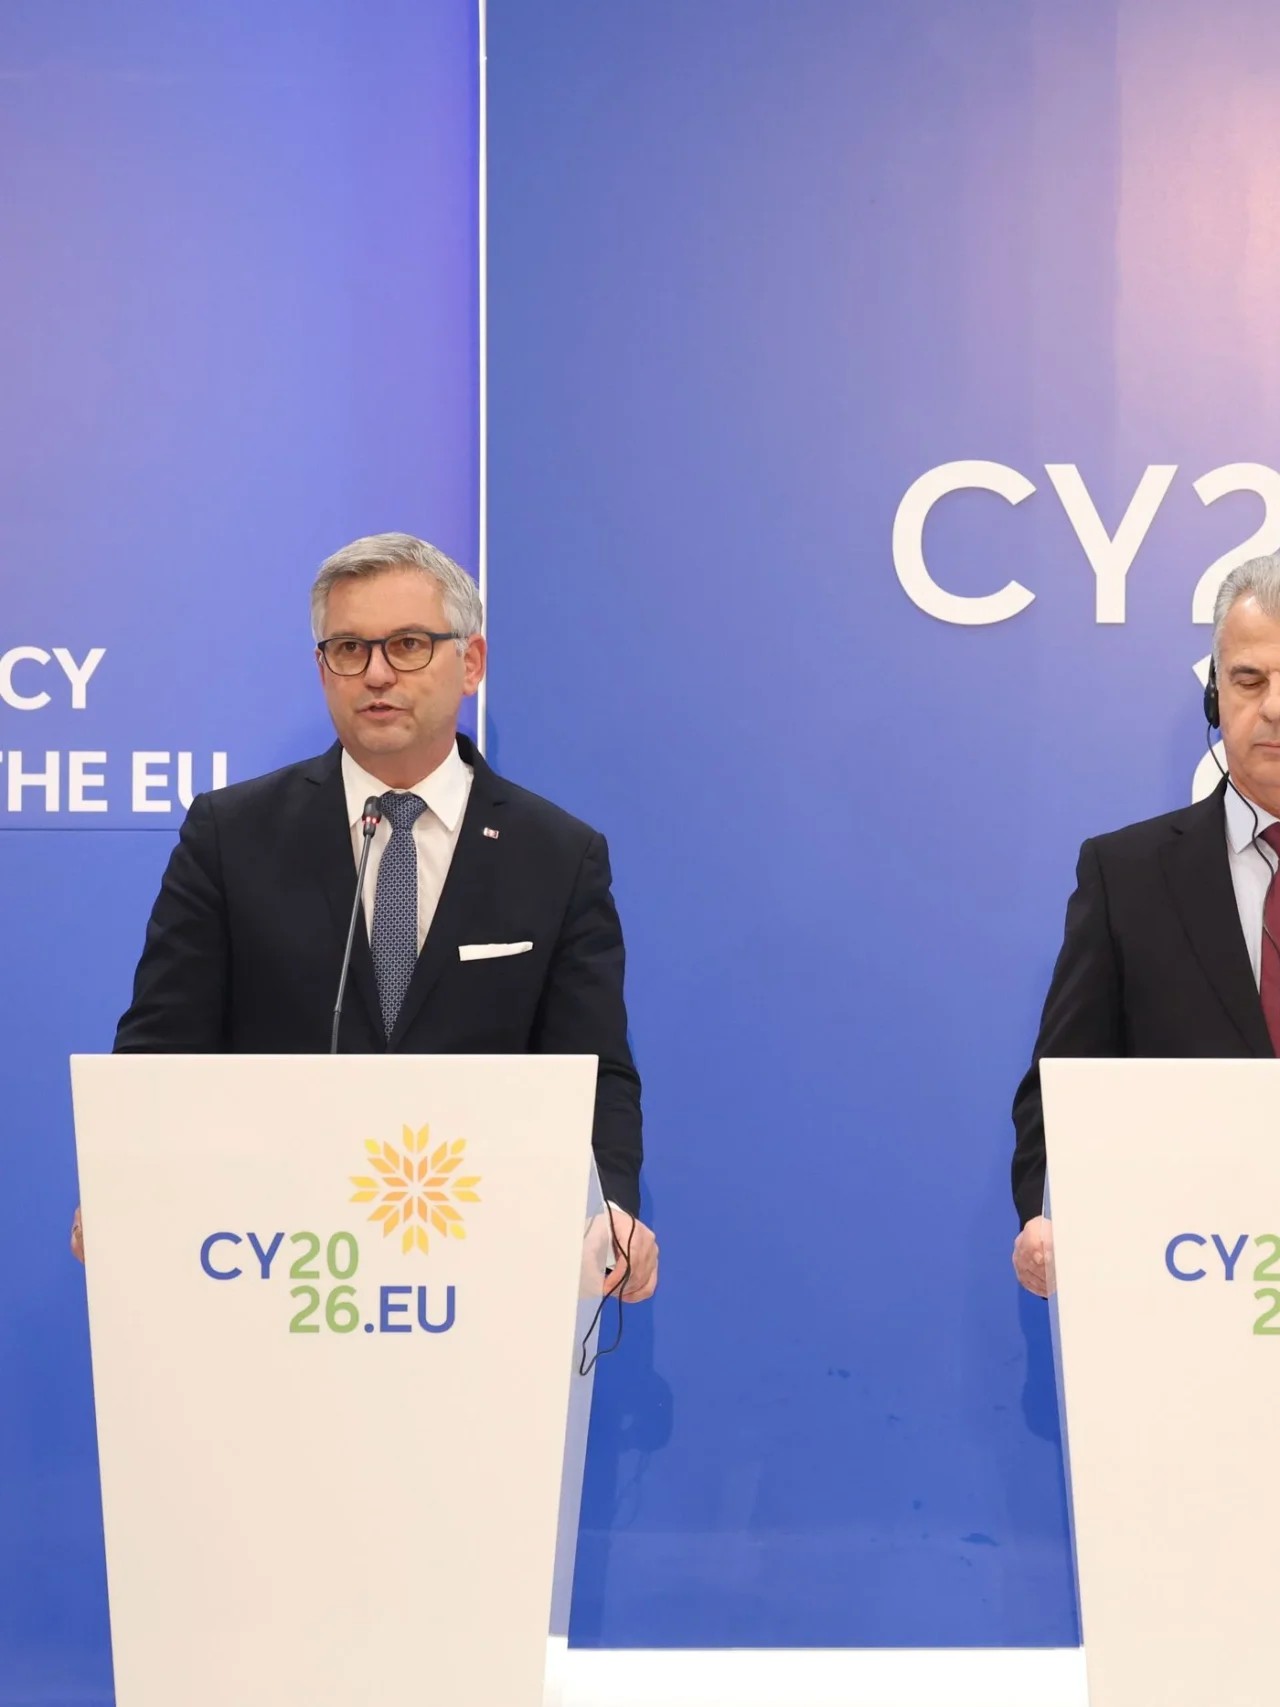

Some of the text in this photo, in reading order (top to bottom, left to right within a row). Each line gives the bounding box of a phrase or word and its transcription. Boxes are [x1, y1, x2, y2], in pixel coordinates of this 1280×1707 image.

[0, 646, 106, 710] CY
[0, 751, 227, 812] HE EU
[200, 1231, 359, 1280] CY20
[289, 1285, 456, 1333] 26.EU
